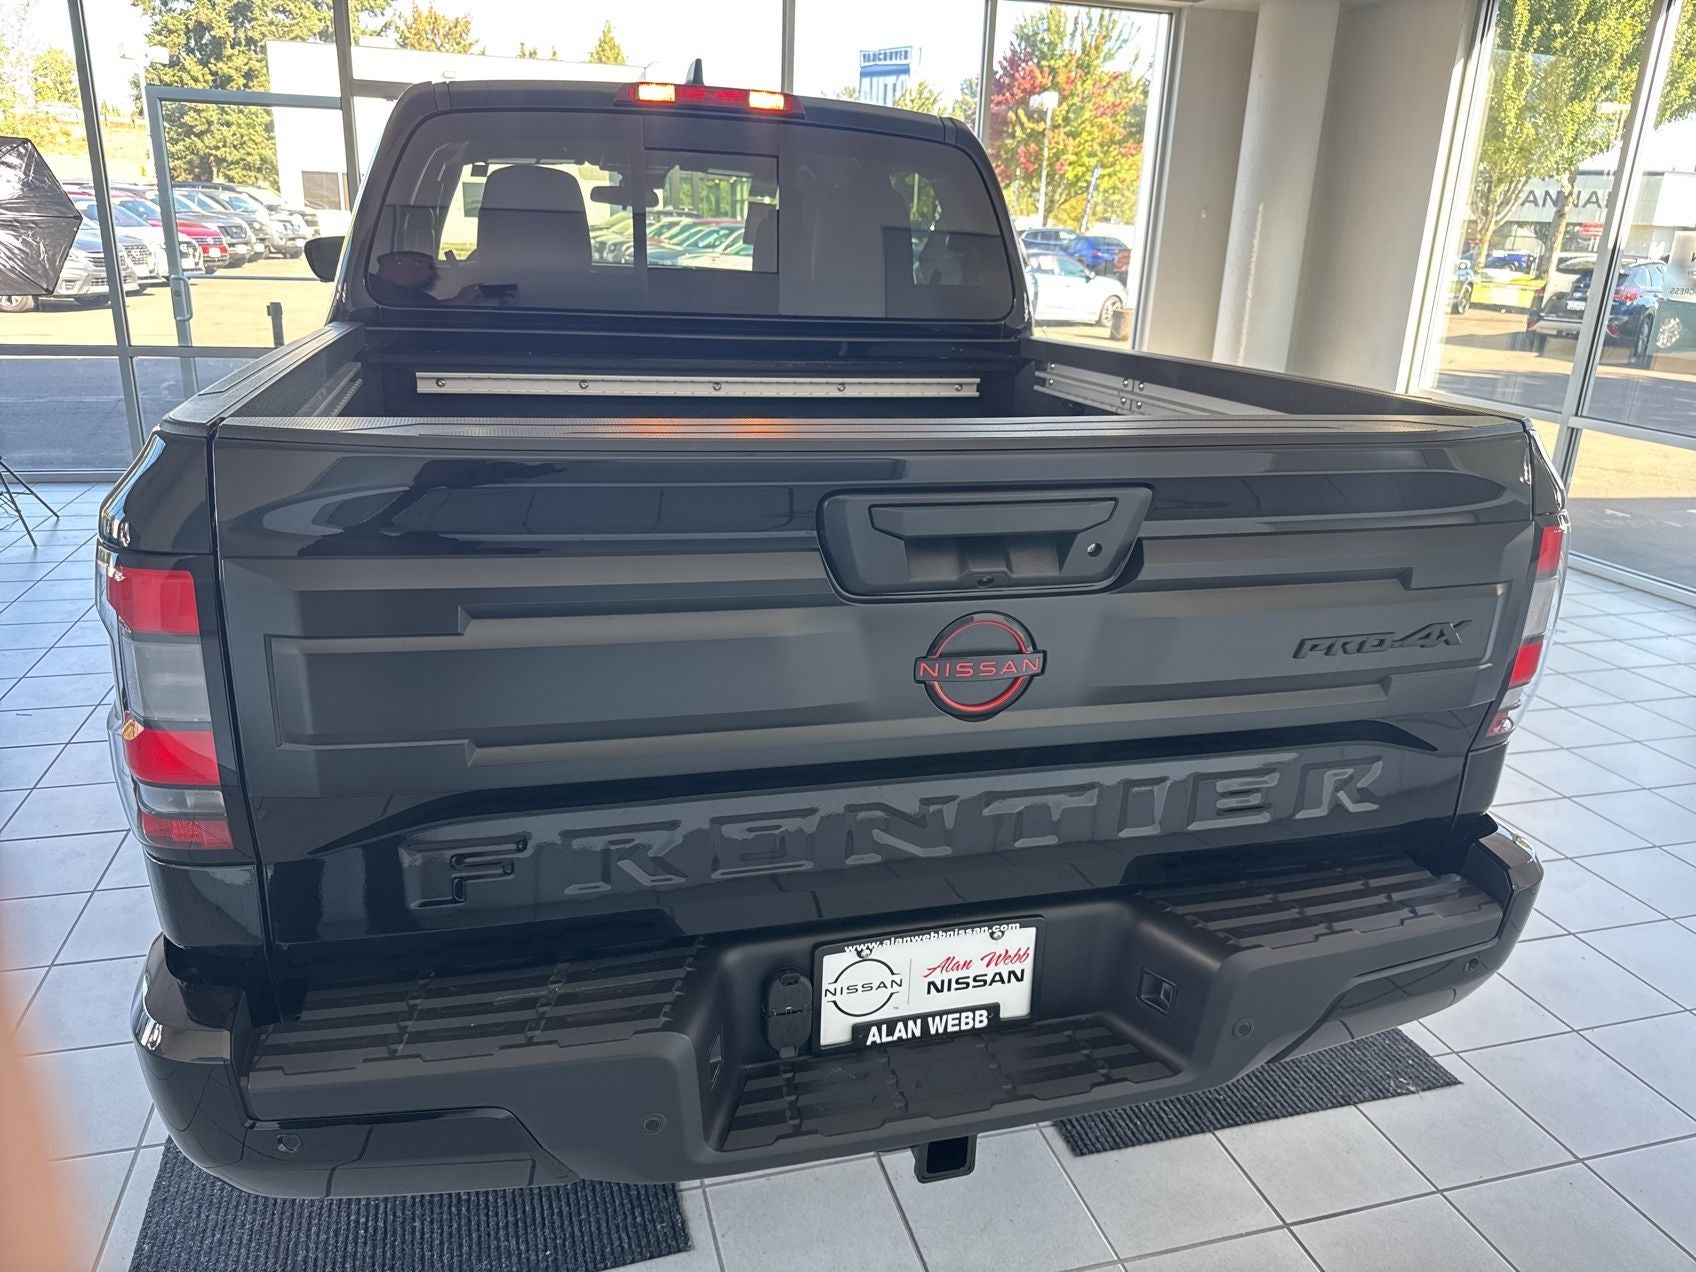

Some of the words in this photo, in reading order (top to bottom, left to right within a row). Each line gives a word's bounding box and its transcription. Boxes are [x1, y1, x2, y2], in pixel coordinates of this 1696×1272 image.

[1292, 619, 1472, 659] PRO-4X
[919, 657, 1040, 678] NISSAN
[403, 755, 1383, 909] FRONTIER
[844, 922, 1020, 954] www.alanwebbnissan.com
[922, 956, 973, 978] Alan
[980, 946, 1031, 969] Webb
[824, 978, 903, 998] NISSAN
[926, 968, 1026, 996] NISSAN
[865, 1018, 922, 1046] ALAN
[927, 1009, 989, 1035] WEBB
